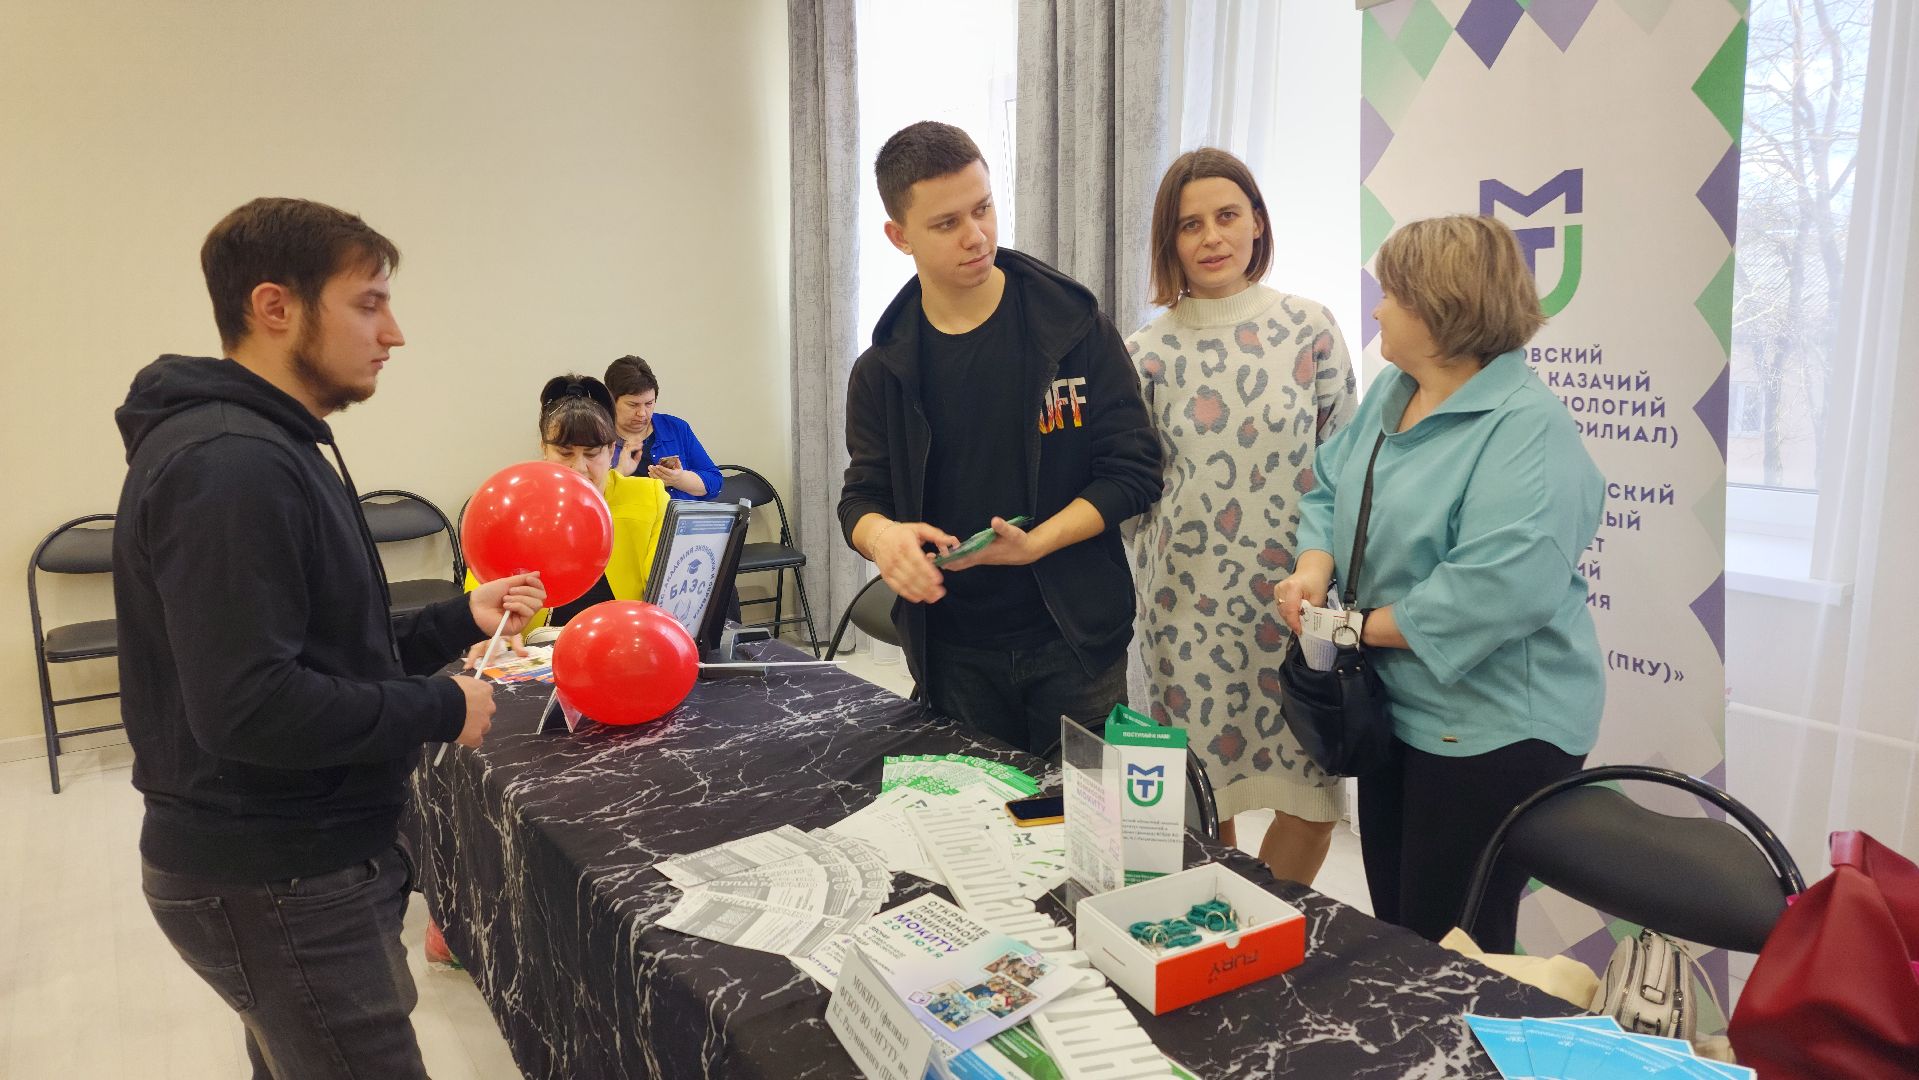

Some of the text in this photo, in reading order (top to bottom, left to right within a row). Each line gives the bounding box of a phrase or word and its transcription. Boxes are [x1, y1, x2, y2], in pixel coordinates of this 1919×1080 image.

[1523, 343, 1602, 365] ВСКИЙ
[1548, 370, 1651, 392] КАЗАЧИЙ
[1600, 509, 1641, 532] ЫЙ
[669, 578, 706, 600] БАЗС
[894, 914, 959, 953] МОКИТУ
[907, 909, 969, 948] КОМИССИИ
[917, 905, 980, 942] ПРИЕМНОЙ
[928, 900, 990, 937] ОТКРЫТИЕ
[883, 920, 901, 931] 20
[903, 933, 944, 958] ИЮНЯ
[853, 976, 880, 1013] МОКИТУ
